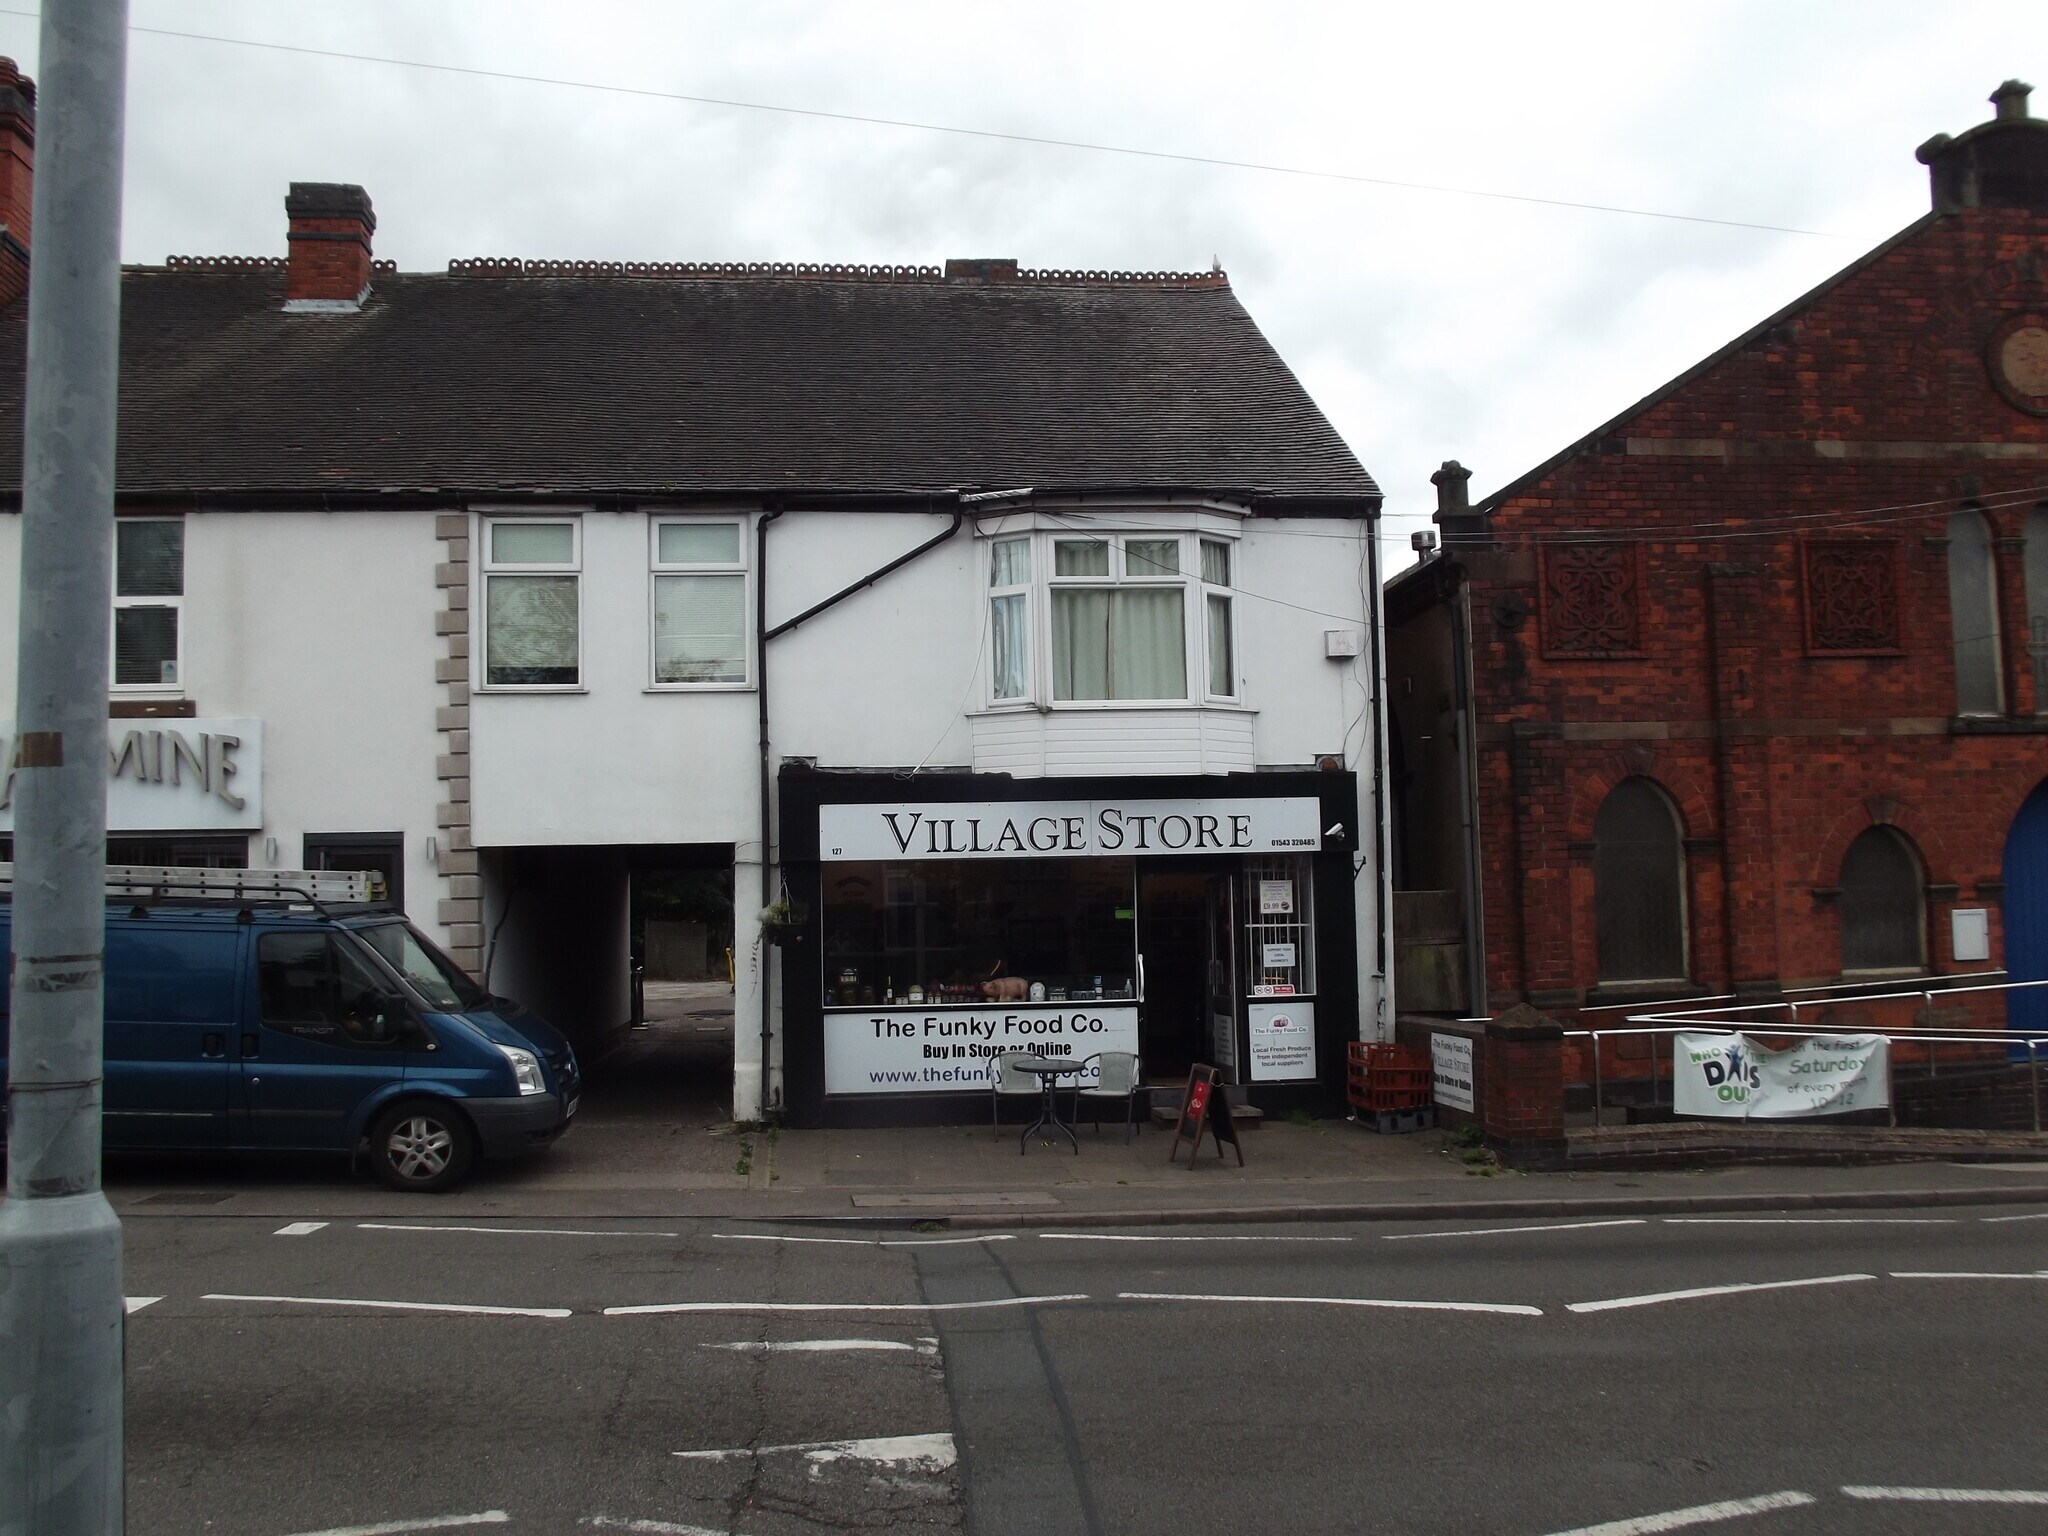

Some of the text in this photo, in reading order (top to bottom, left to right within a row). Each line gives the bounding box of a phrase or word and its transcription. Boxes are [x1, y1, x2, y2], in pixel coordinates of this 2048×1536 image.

[882, 808, 1254, 854] VILLAGE STORE
[831, 847, 843, 855] 127
[291, 1026, 336, 1035] TRANSIT
[870, 1013, 1109, 1040] The Funky Food Co.
[923, 1044, 949, 1060] Buy
[952, 1043, 966, 1058] In
[969, 1043, 1006, 1058] Store
[1028, 1042, 1072, 1056] Online
[1812, 1041, 1830, 1051] the
[1834, 1040, 1860, 1051] first
[1690, 1047, 1721, 1062] WHO
[1789, 1056, 1865, 1075] Saturday
[1788, 1082, 1800, 1093] of
[1803, 1082, 1836, 1093] every
